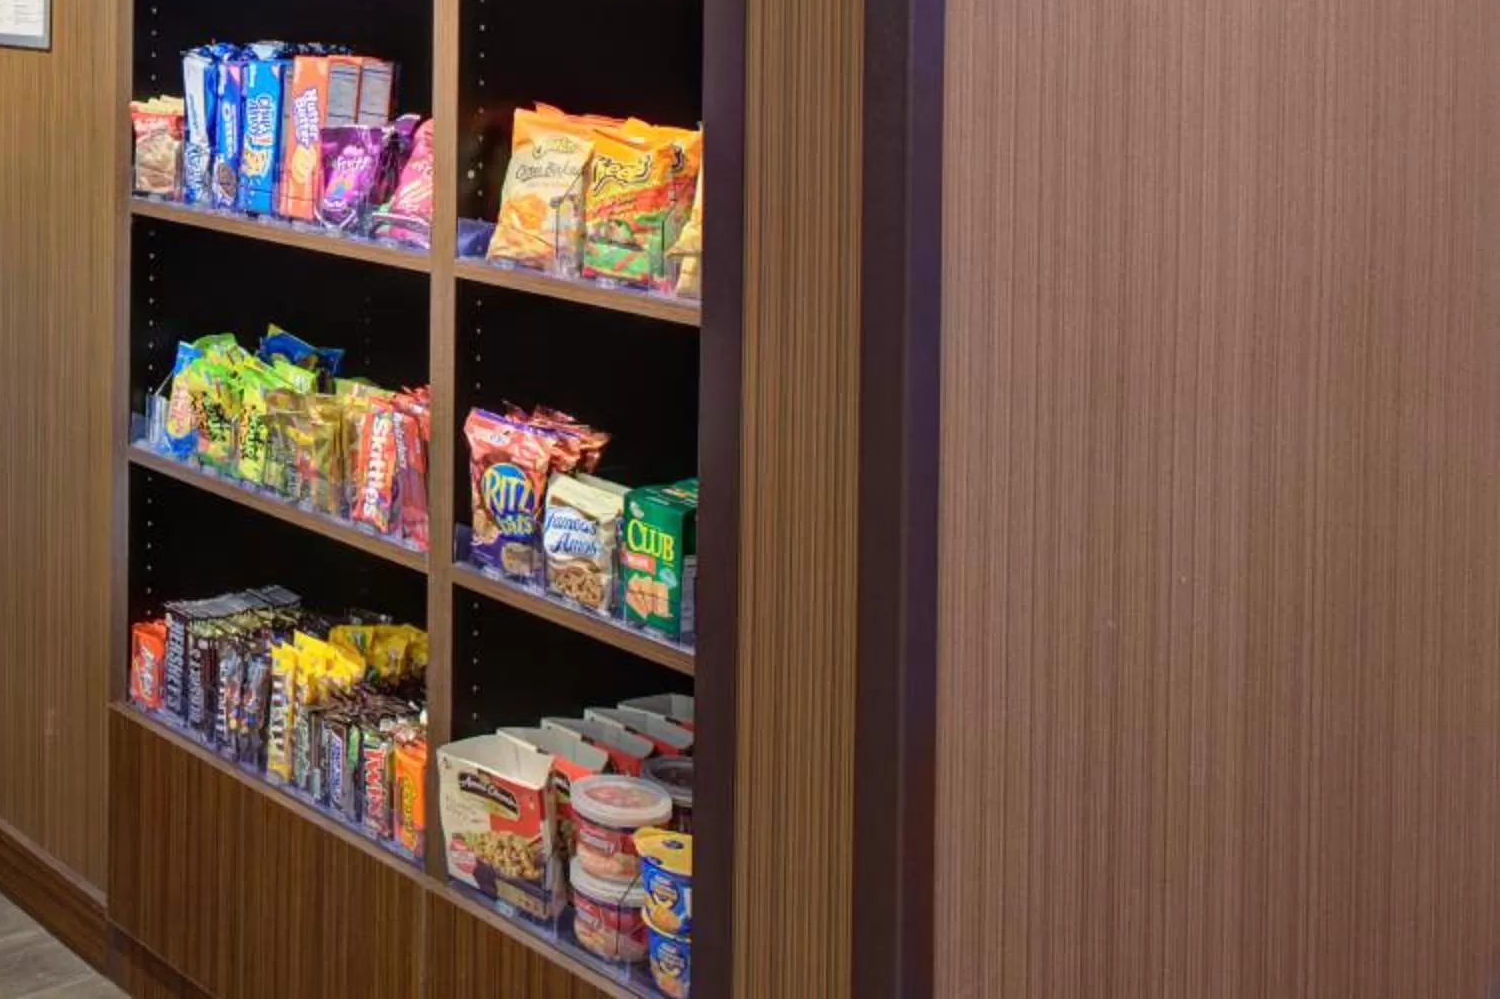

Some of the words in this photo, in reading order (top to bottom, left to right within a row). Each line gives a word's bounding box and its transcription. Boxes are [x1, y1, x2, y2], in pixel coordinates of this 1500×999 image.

[364, 417, 391, 517] Skittles
[484, 468, 534, 515] RITZ
[545, 513, 598, 536] Famous
[551, 532, 598, 555] Amos
[627, 518, 676, 564] CLUB
